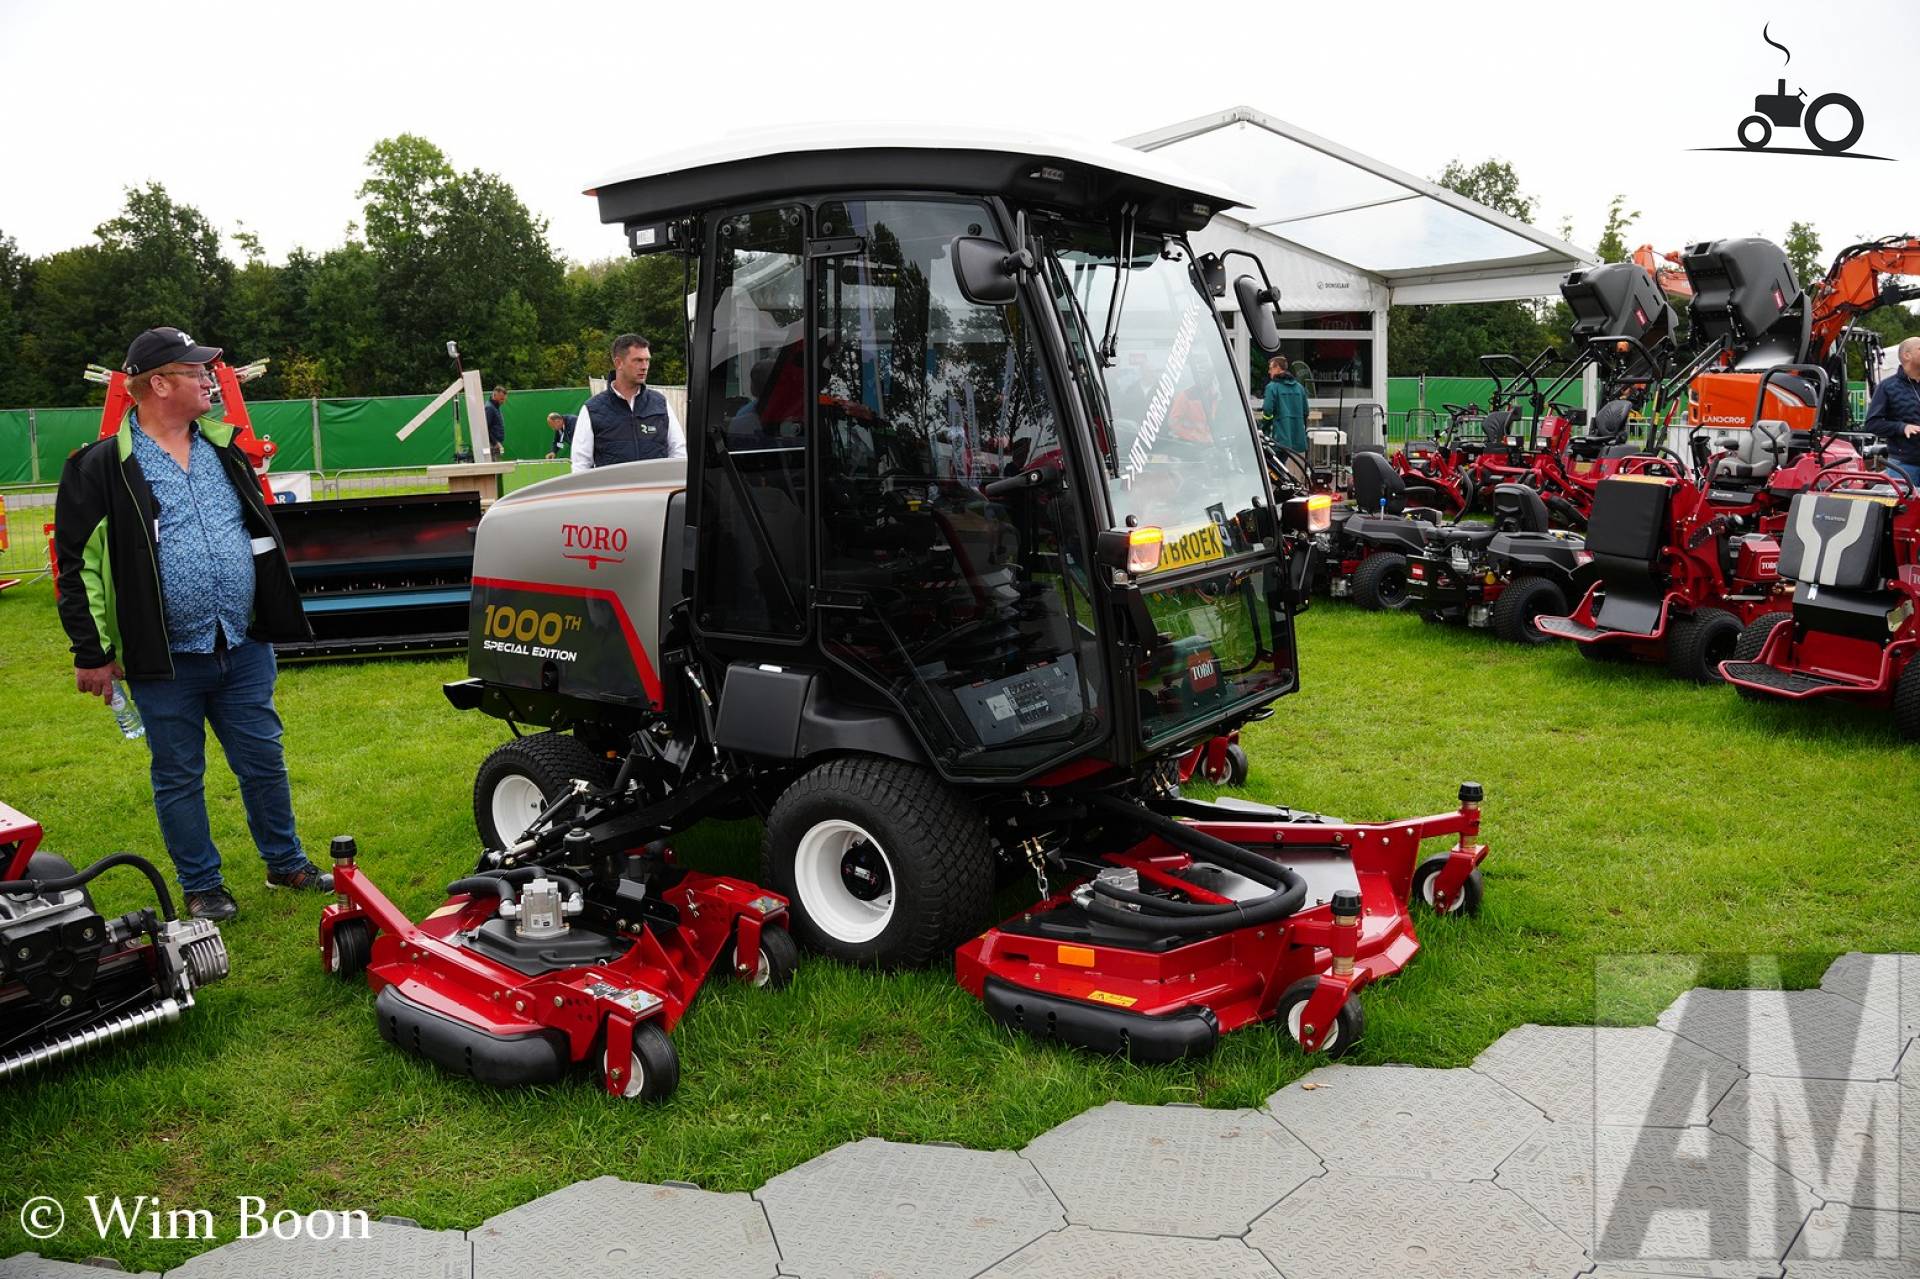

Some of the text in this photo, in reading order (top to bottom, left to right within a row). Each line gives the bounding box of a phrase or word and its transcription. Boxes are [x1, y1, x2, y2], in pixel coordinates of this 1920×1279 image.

[1702, 416, 1746, 424] LANDCROS
[561, 524, 628, 552] TORO
[483, 640, 578, 661] SPECIAL EDITION
[1191, 660, 1215, 681] TORO
